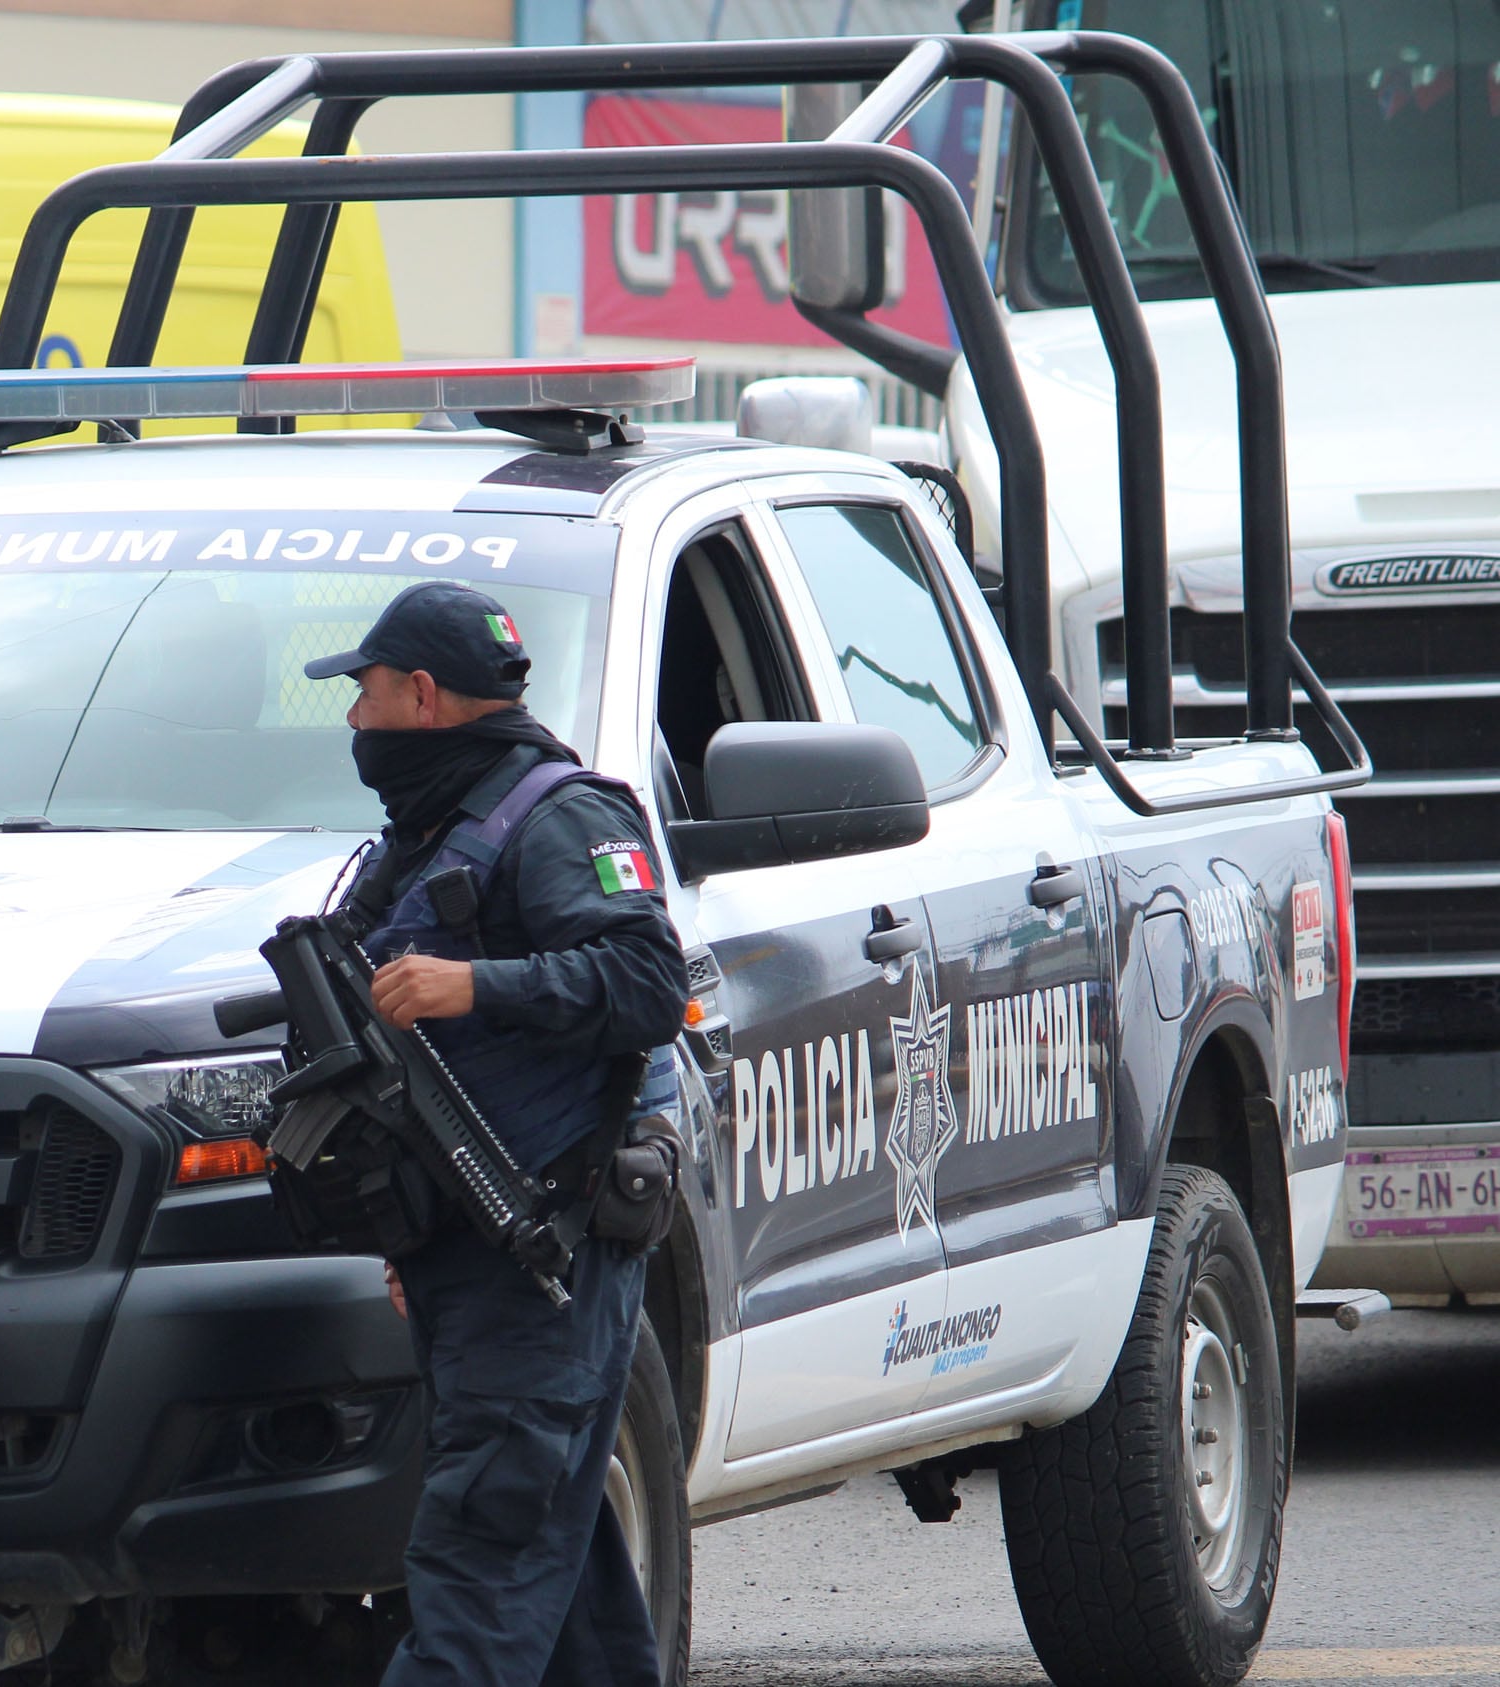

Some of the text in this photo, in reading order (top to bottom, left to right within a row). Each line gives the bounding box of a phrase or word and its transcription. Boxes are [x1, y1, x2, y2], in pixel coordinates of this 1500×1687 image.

[1336, 558, 1500, 586] FREIGHTLINER
[590, 841, 641, 857] MÉXICO
[1295, 894, 1320, 928] 911
[910, 1047, 934, 1073] SSPVB
[733, 981, 1097, 1209] POLICIA MUNICIPAL
[893, 1303, 1002, 1366] CUAUTLANCINGO
